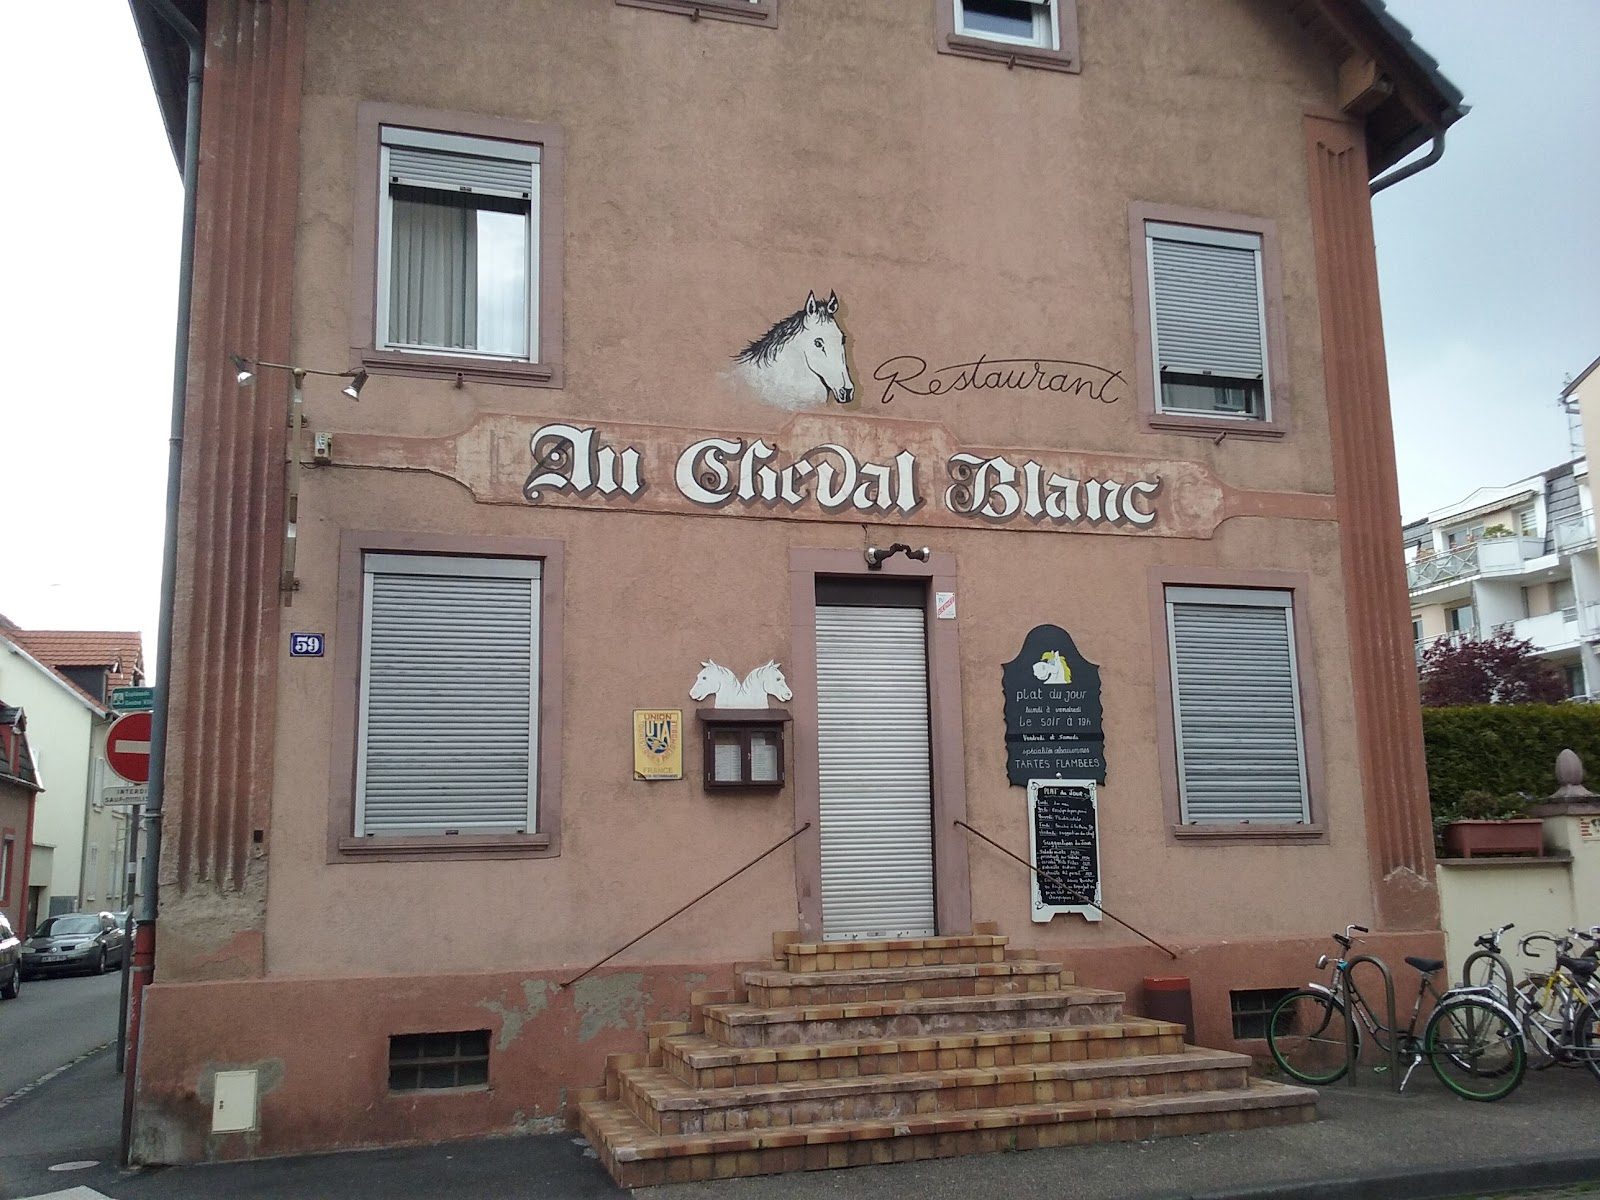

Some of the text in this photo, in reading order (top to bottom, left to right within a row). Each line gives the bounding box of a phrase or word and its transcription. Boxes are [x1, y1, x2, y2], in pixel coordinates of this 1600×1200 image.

[873, 354, 1128, 404] Restaurant
[524, 423, 645, 502] Au
[946, 451, 1161, 526] Blanc
[295, 636, 320, 653] 59
[1016, 688, 1087, 703] plat du jour
[1040, 717, 1060, 727] soir
[1067, 715, 1073, 727] à
[1078, 717, 1091, 726] 19h
[1015, 759, 1051, 769] TARTES
